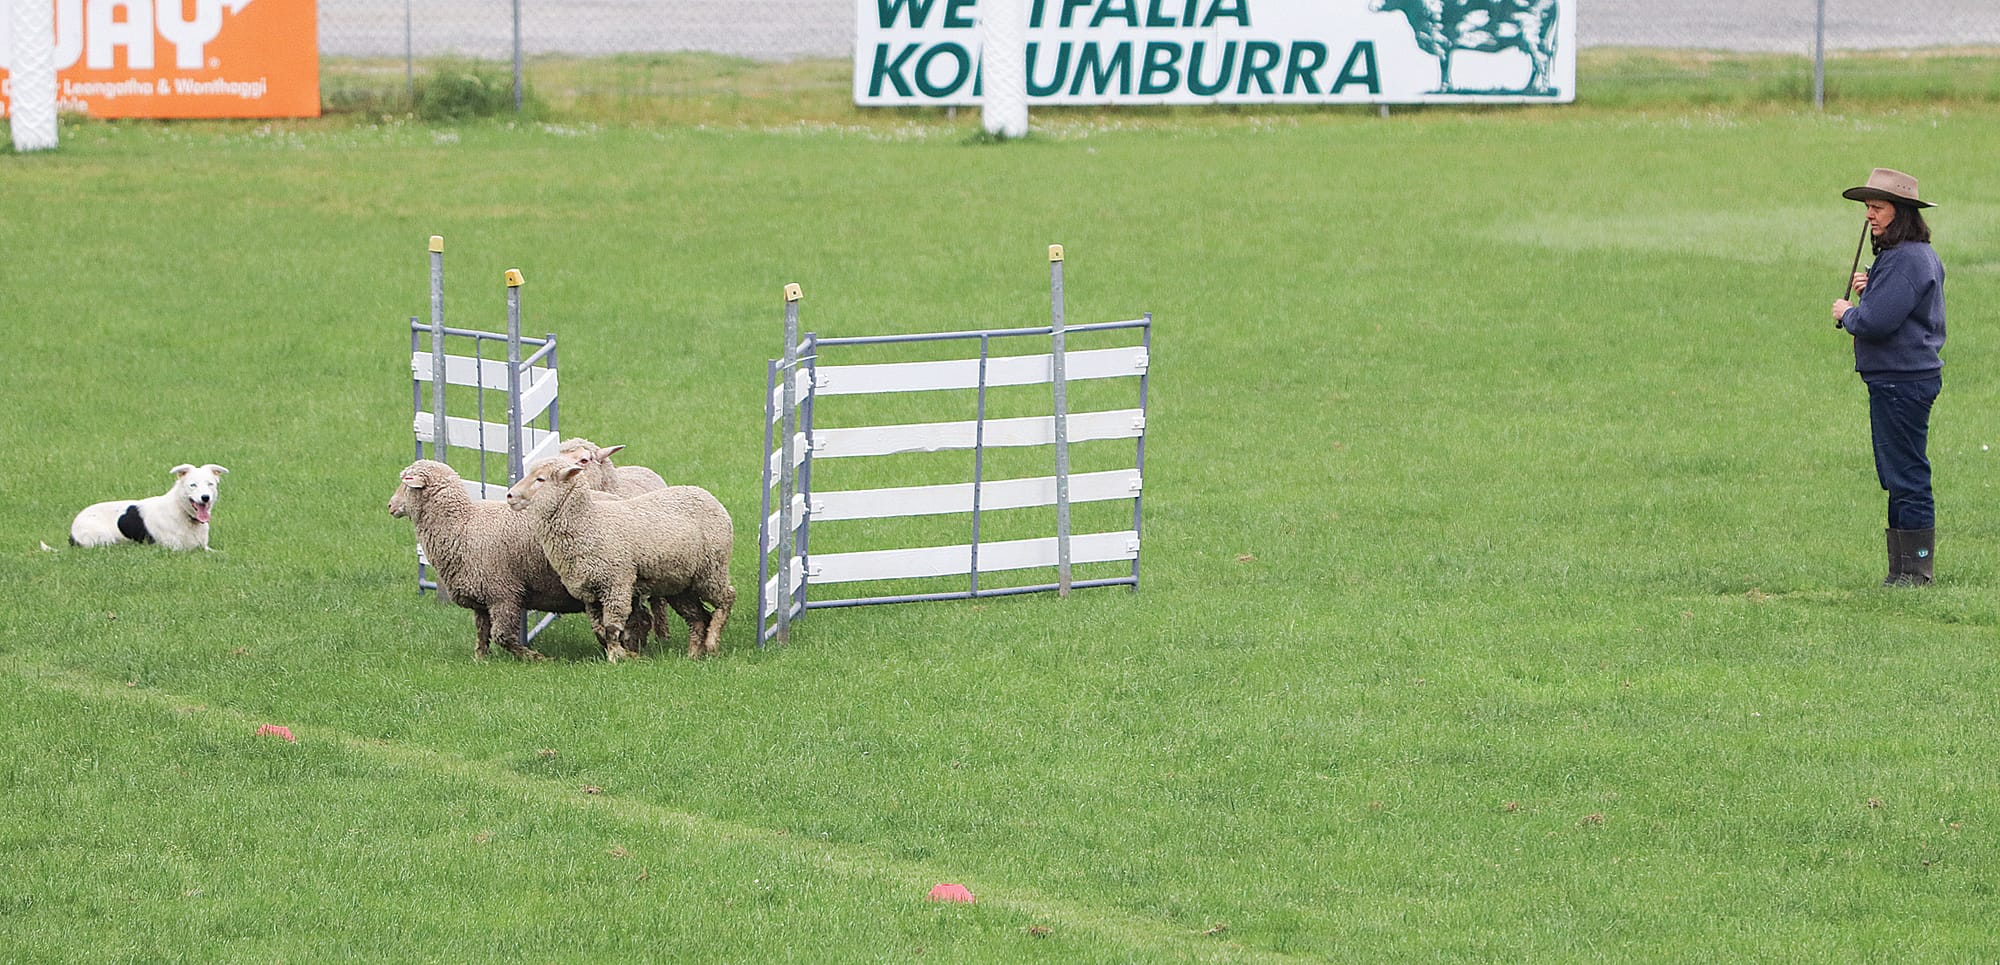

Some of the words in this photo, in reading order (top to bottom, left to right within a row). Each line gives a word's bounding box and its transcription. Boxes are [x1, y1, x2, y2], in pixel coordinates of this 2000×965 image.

[876, 0, 1250, 28] WETFALIA
[868, 40, 1382, 97] KOUMBURRA
[157, 78, 171, 95] &
[174, 78, 267, 98] Wonthaggi
